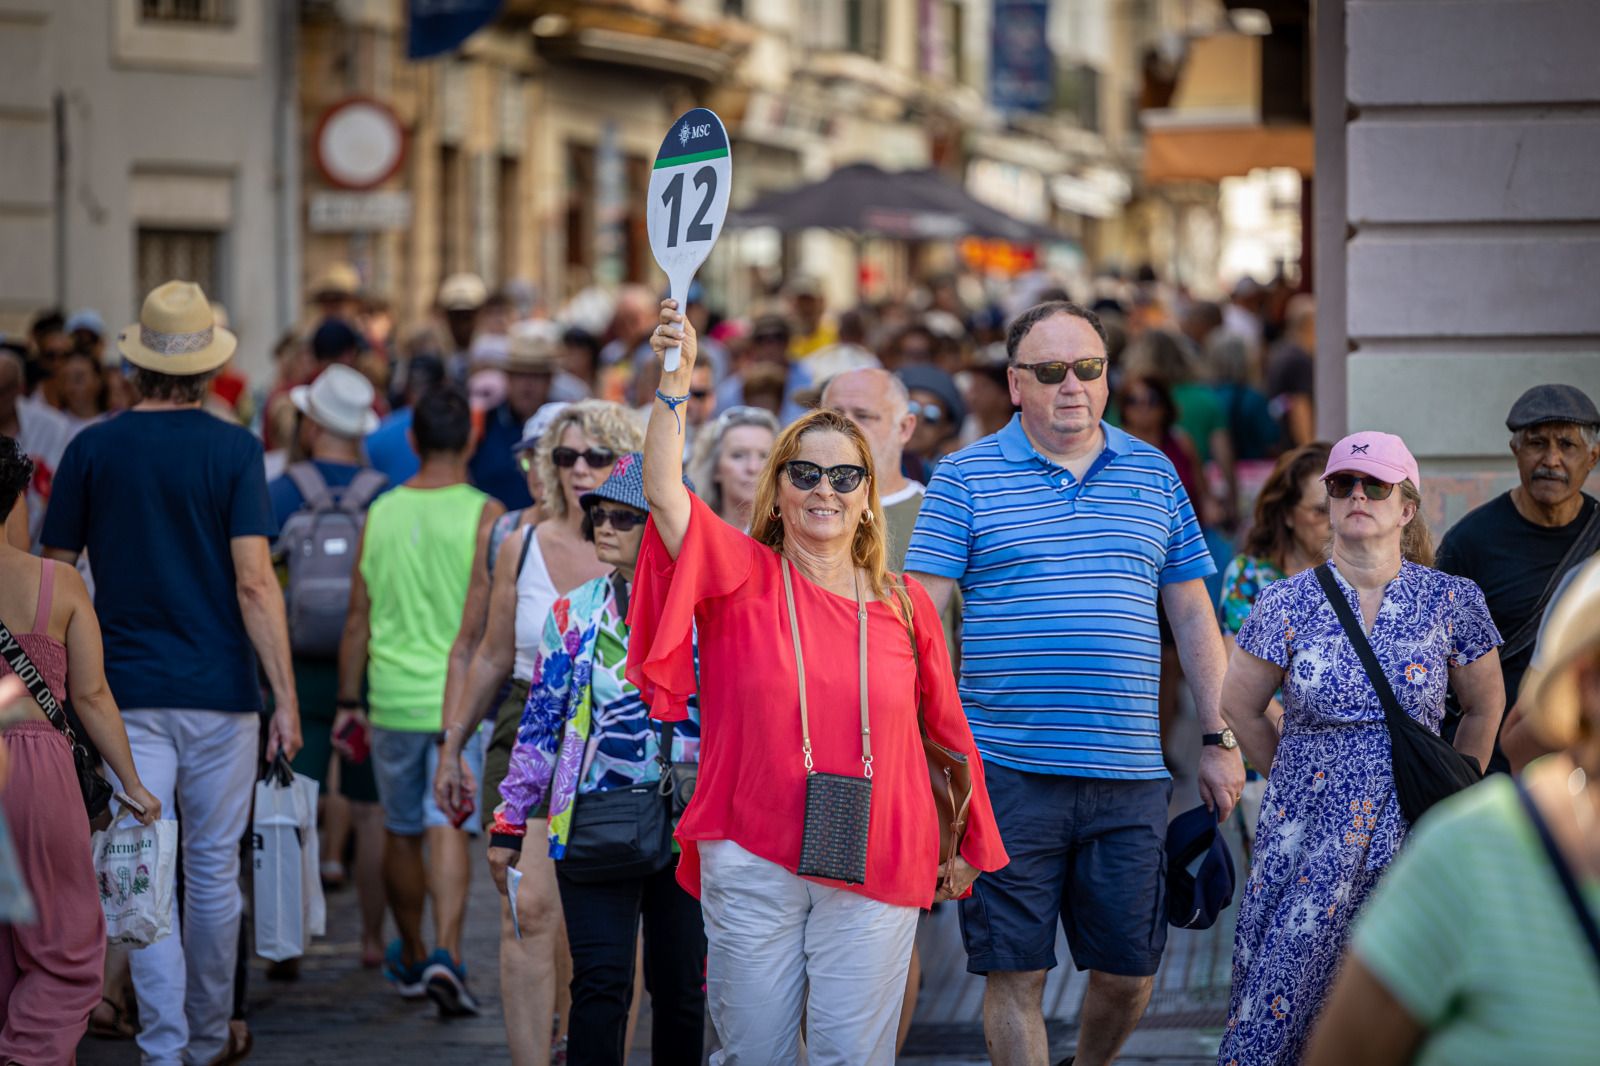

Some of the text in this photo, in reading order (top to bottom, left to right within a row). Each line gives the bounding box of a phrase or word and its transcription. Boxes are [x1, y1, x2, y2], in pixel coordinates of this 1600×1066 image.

[691, 123, 711, 139] MSC
[661, 165, 718, 248] 12
[10, 652, 43, 689] NOT
